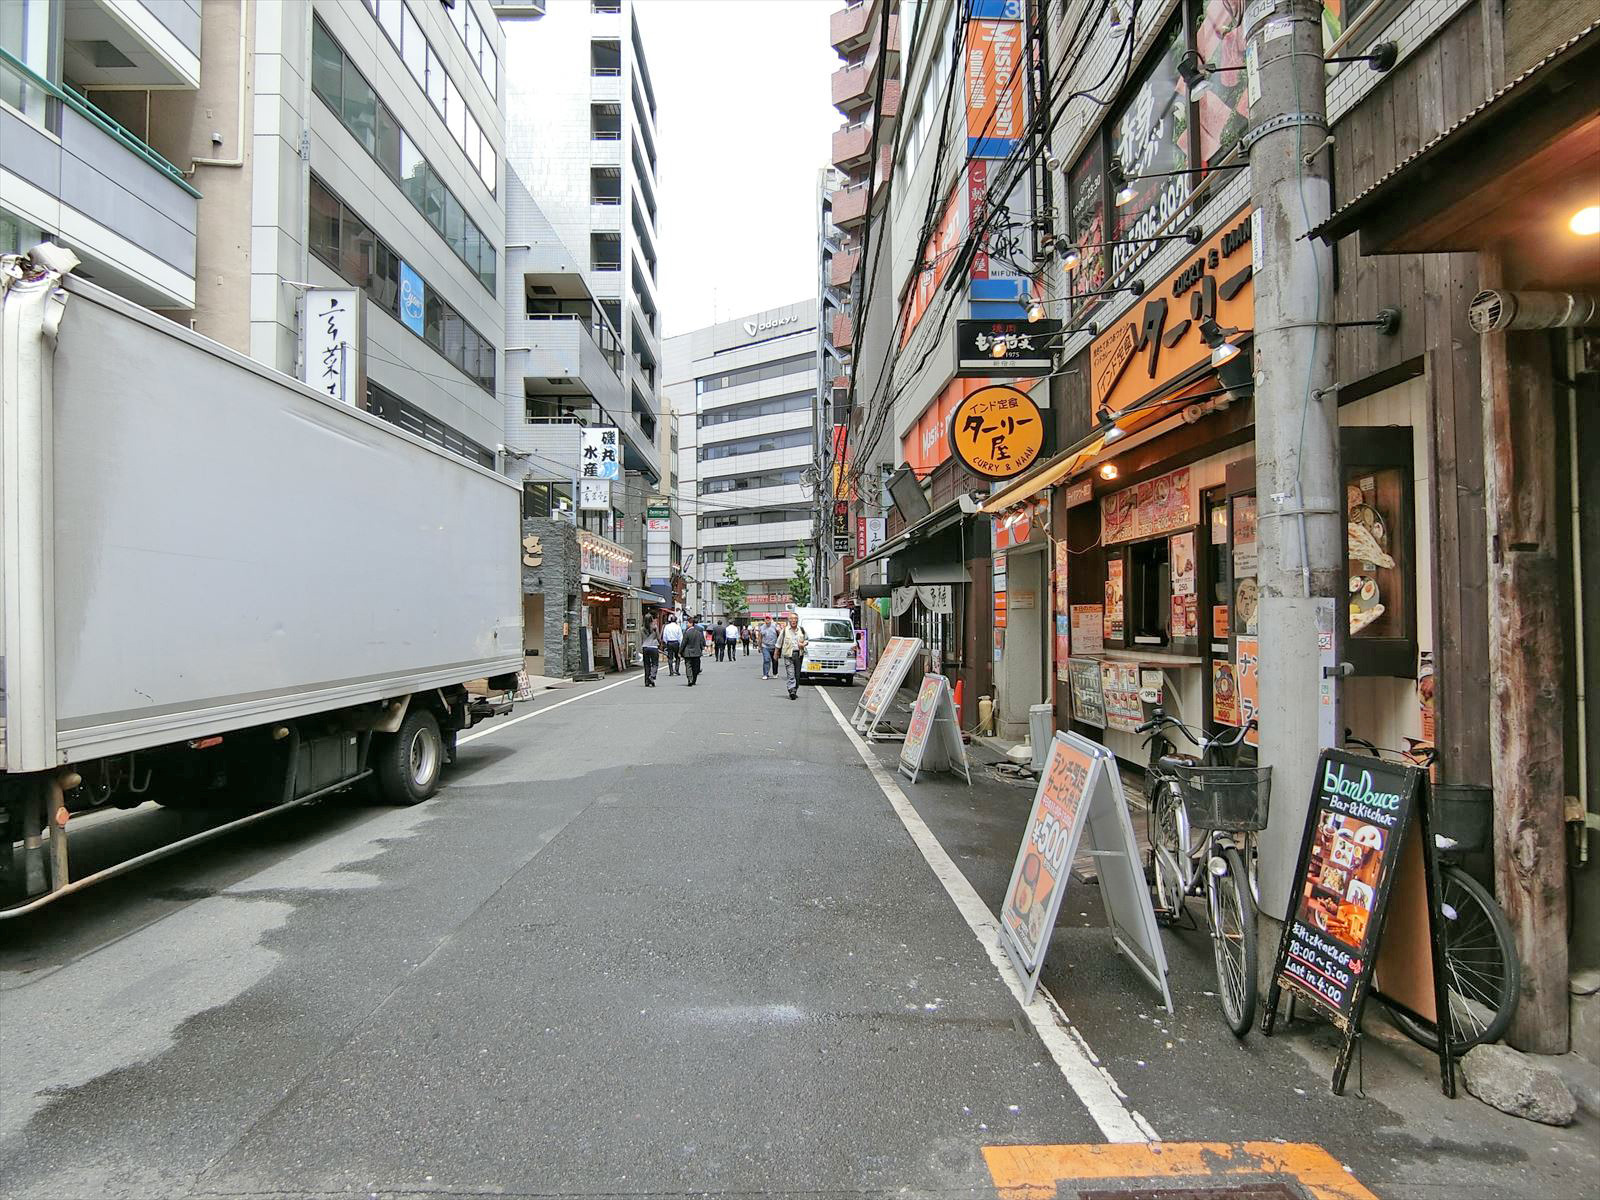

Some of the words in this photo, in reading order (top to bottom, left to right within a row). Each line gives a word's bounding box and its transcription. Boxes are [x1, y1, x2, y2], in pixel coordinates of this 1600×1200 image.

[982, 22, 1016, 86] Music
[995, 88, 1013, 136] man
[758, 315, 798, 331] odakyu
[970, 397, 1018, 415] インド定食
[963, 415, 1034, 443] ターリー
[583, 445, 598, 476] 水産
[602, 430, 616, 462] 磯丸
[973, 456, 1000, 472] CURRY
[1005, 463, 1011, 472] &
[1016, 447, 1035, 468] NAAN
[991, 435, 1011, 461] 屋
[1144, 690, 1156, 698] OPEN
[1032, 811, 1069, 870] ¥500
[1284, 957, 1305, 979] Last
[1306, 971, 1316, 985] in
[1317, 977, 1342, 1002] 4:00
